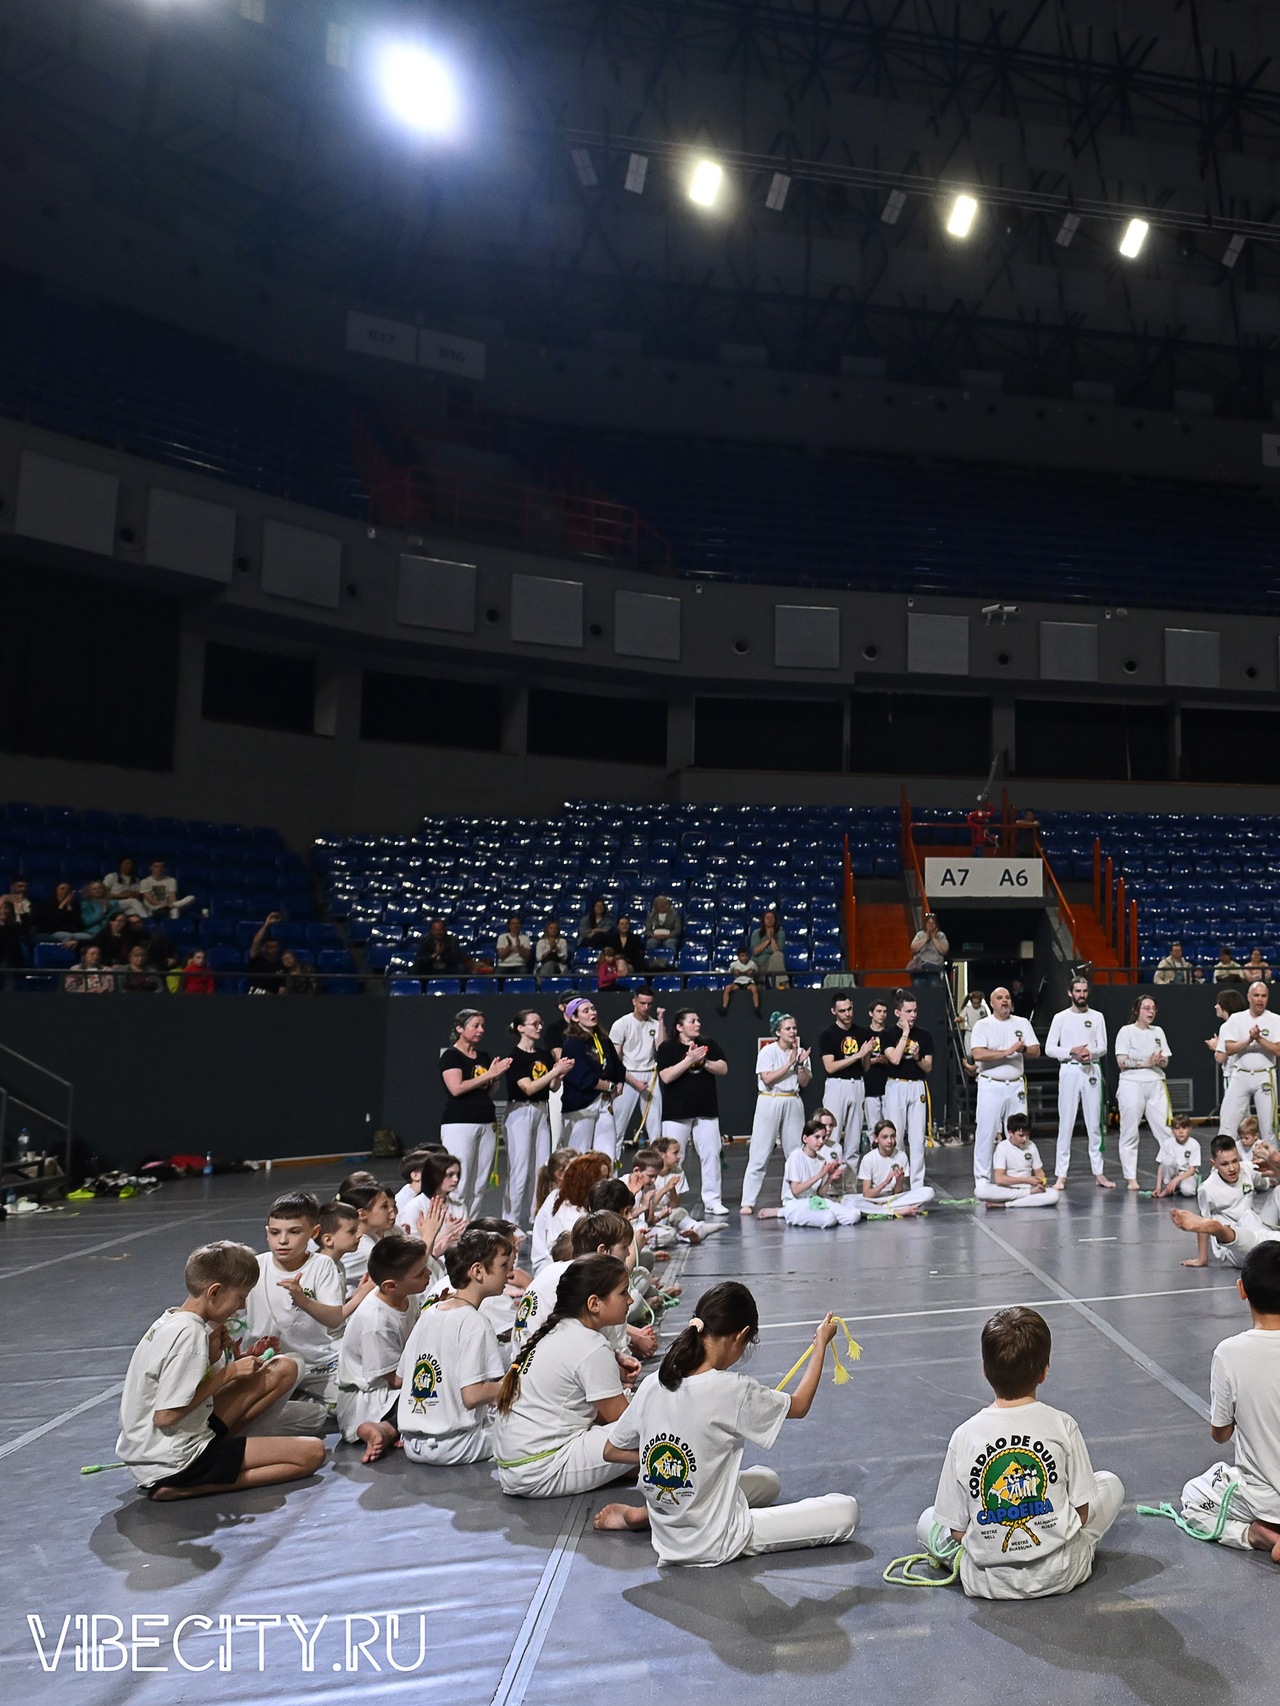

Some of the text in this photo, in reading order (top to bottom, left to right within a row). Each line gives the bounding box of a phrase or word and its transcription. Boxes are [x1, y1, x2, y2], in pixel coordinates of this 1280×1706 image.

[940, 868, 1029, 886] A7 A6
[431, 1359, 442, 1384] OURO
[668, 1433, 681, 1446] DE
[681, 1442, 697, 1473] OURO
[969, 1435, 1058, 1499] CORDÃO DE OURO
[976, 1498, 1054, 1526] CAPOEIRA
